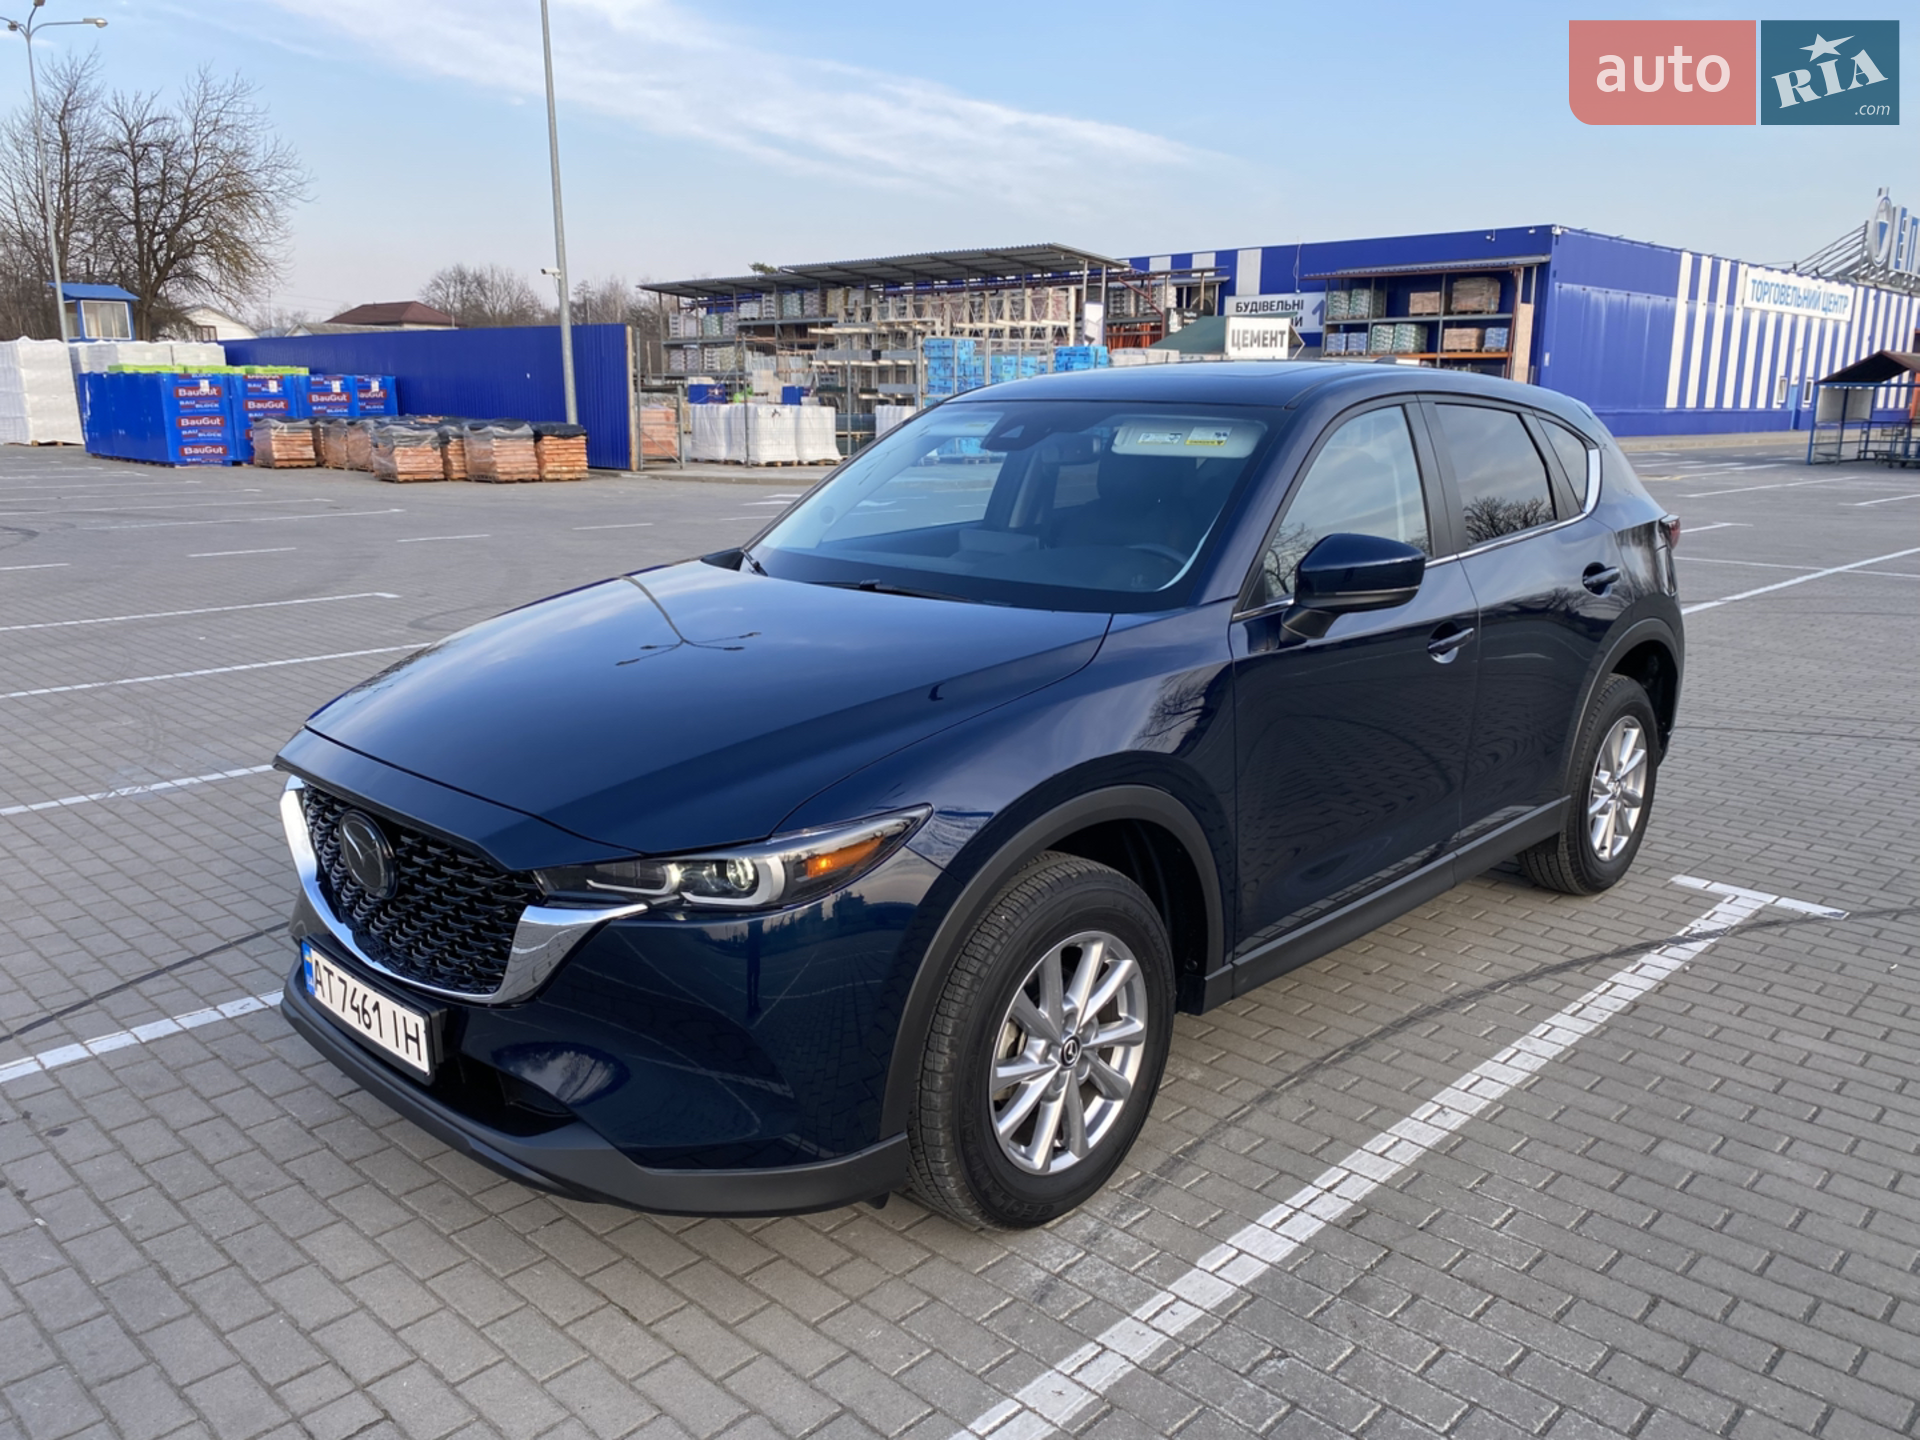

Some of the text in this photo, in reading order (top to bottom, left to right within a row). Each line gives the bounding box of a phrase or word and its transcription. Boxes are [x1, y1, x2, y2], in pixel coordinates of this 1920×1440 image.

[1751, 279, 1849, 315] ТОРГОВЕЛЬНИЙ ЦЕНТР
[1235, 299, 1304, 313] БУДІВЕЛЬНІ
[1231, 329, 1286, 351] ЦЕМЕНТ
[311, 393, 347, 402] BauGut
[358, 390, 384, 399] auGut
[247, 401, 285, 409] BauGut
[181, 417, 221, 426] BauGut
[184, 446, 224, 455] BauGut
[314, 958, 422, 1062] AT 7461 IH
